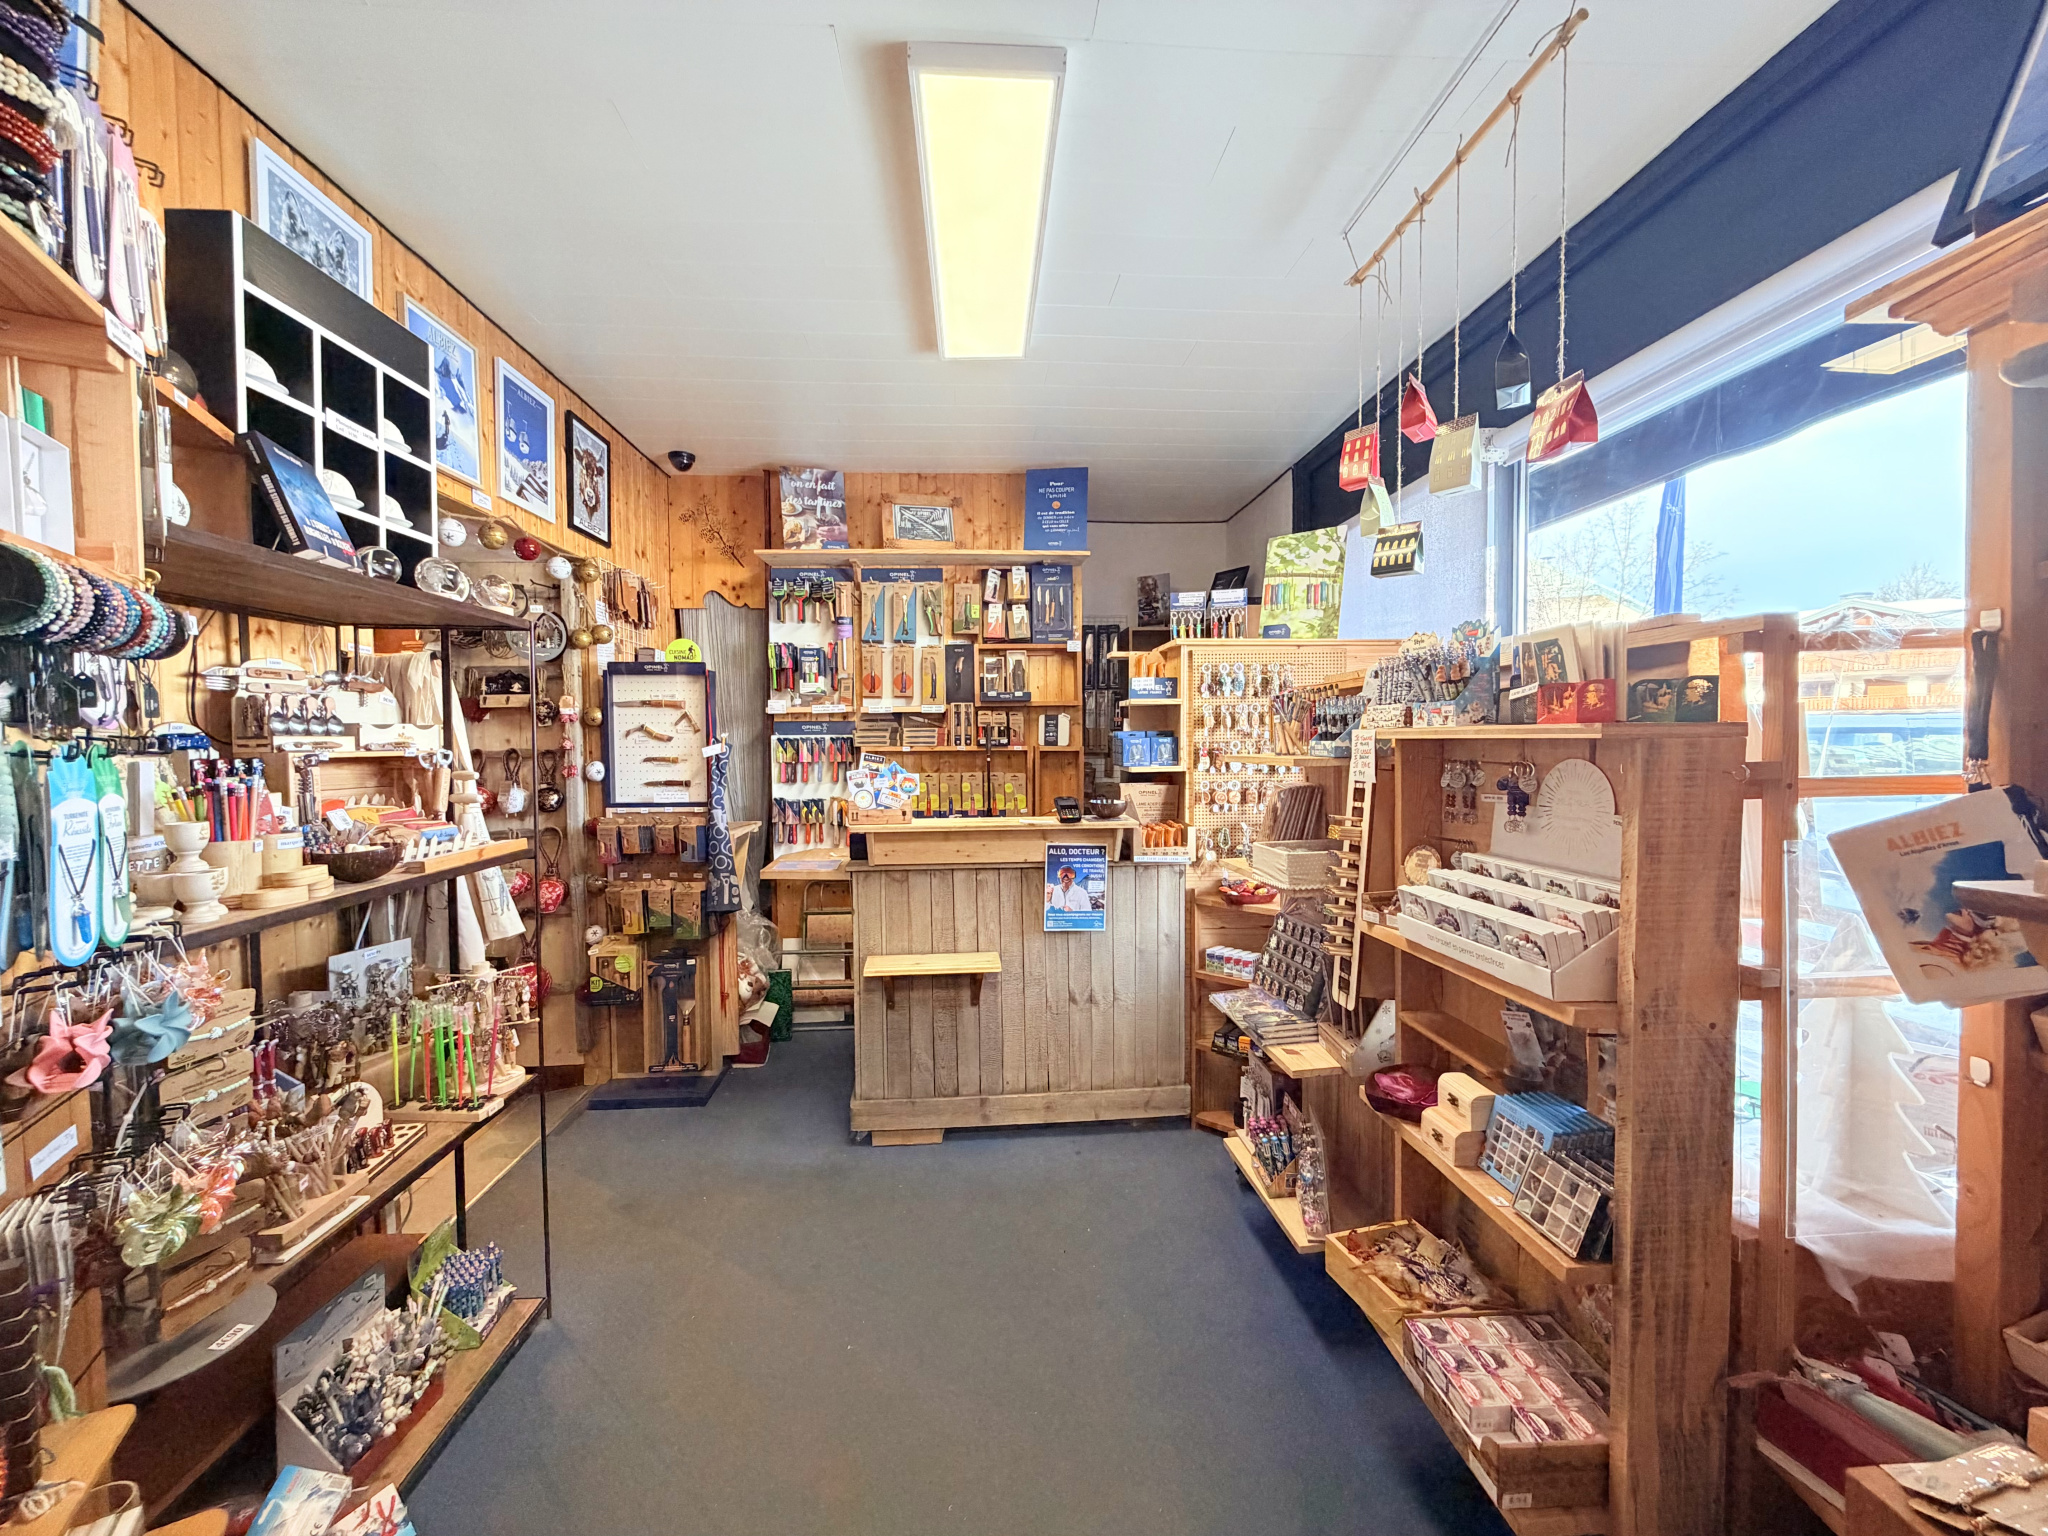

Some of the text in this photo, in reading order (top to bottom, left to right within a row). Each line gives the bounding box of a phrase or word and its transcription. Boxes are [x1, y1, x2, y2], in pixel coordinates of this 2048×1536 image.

[428, 325, 457, 357] ALBIEZ
[516, 388, 537, 408] ALBIEZ
[804, 481, 816, 489] en
[816, 480, 836, 495] fait
[785, 495, 843, 508] des tartines
[865, 754, 884, 762] ALBIEZ
[1886, 821, 1965, 852] ALBIEZ
[1048, 848, 1067, 856] ALLO,
[1900, 840, 1960, 857] Les Aiguilles d'Arves
[1458, 946, 1475, 958] pierres
[215, 1327, 244, 1348] 4€90
